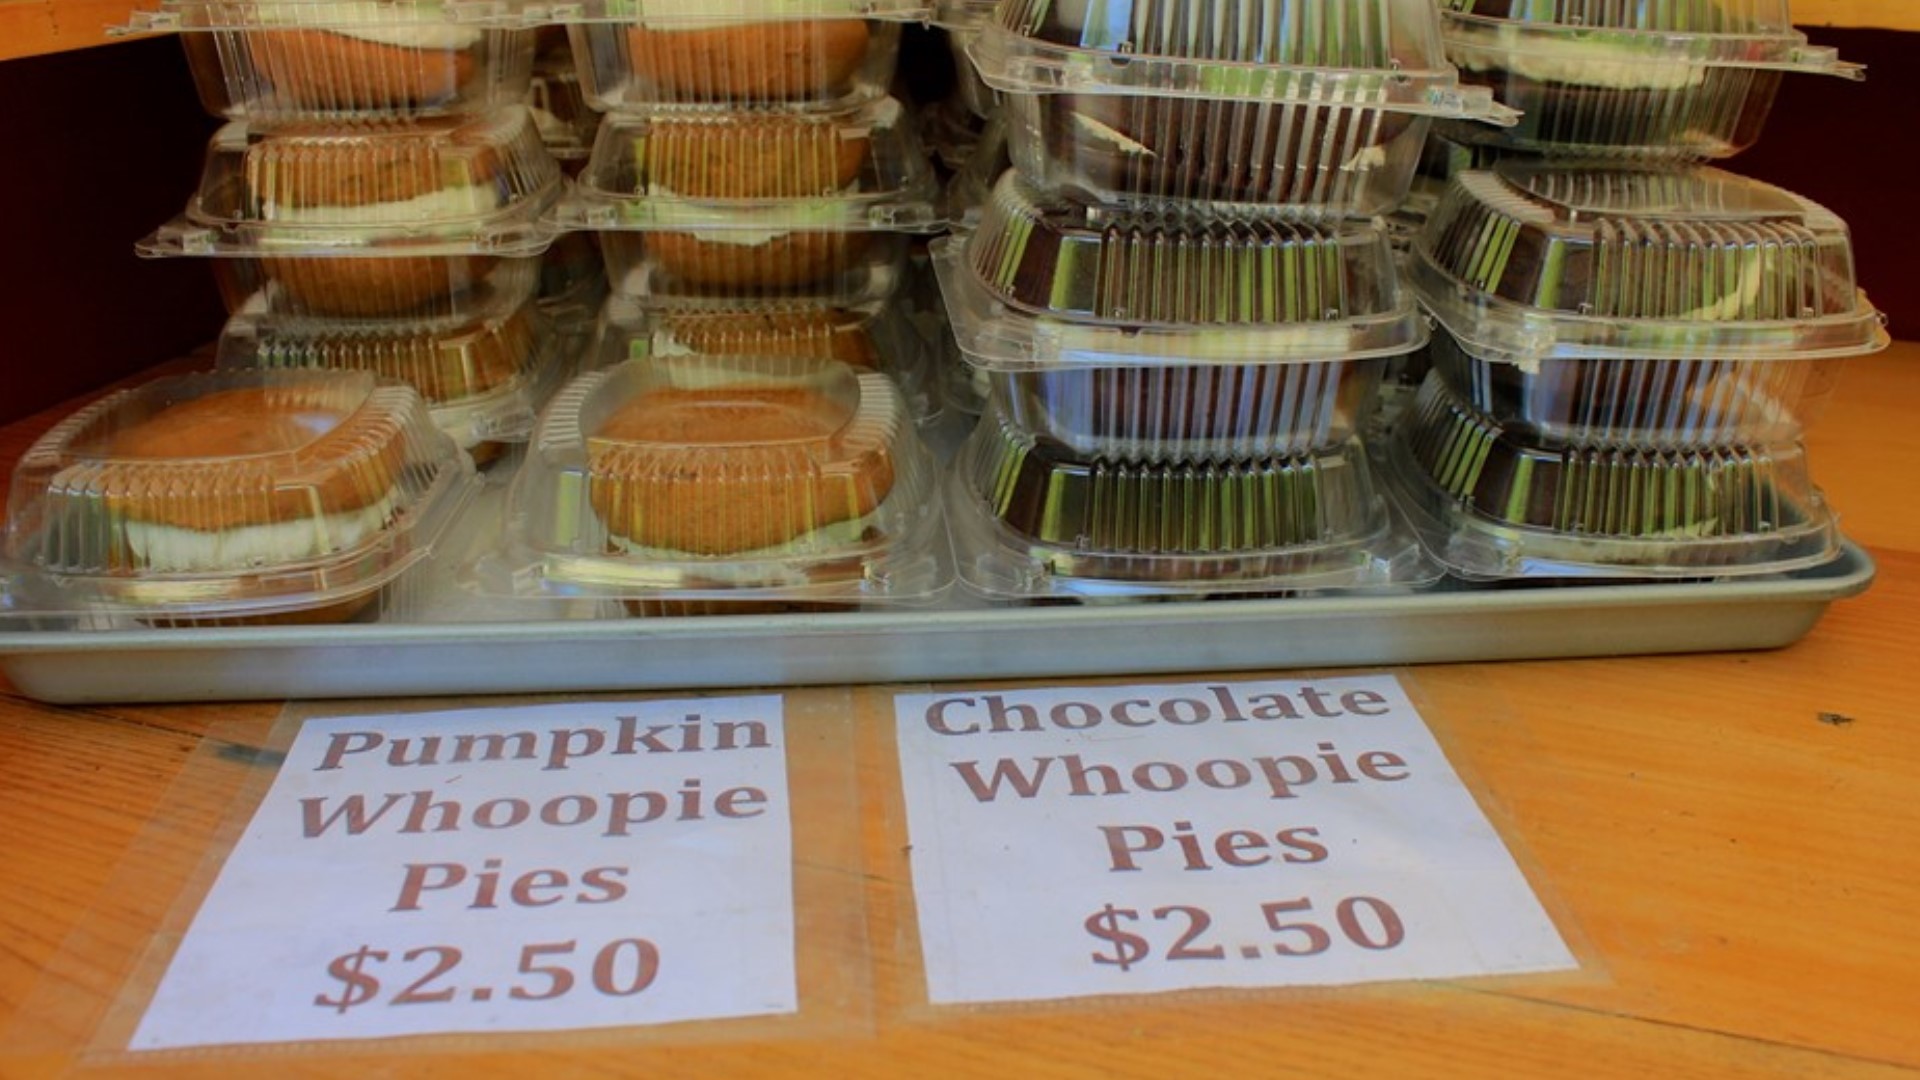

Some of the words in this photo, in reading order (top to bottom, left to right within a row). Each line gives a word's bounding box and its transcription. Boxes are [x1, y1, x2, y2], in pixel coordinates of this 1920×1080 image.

[924, 683, 1392, 736] Chocolate
[312, 713, 772, 773] Pumpkin
[948, 741, 1411, 803] Whoopie
[298, 778, 768, 839] Whoopie
[1097, 820, 1329, 872] Pies
[388, 858, 629, 912] Pies
[1083, 895, 1405, 972] $2.50
[313, 938, 661, 1014] $2.50
